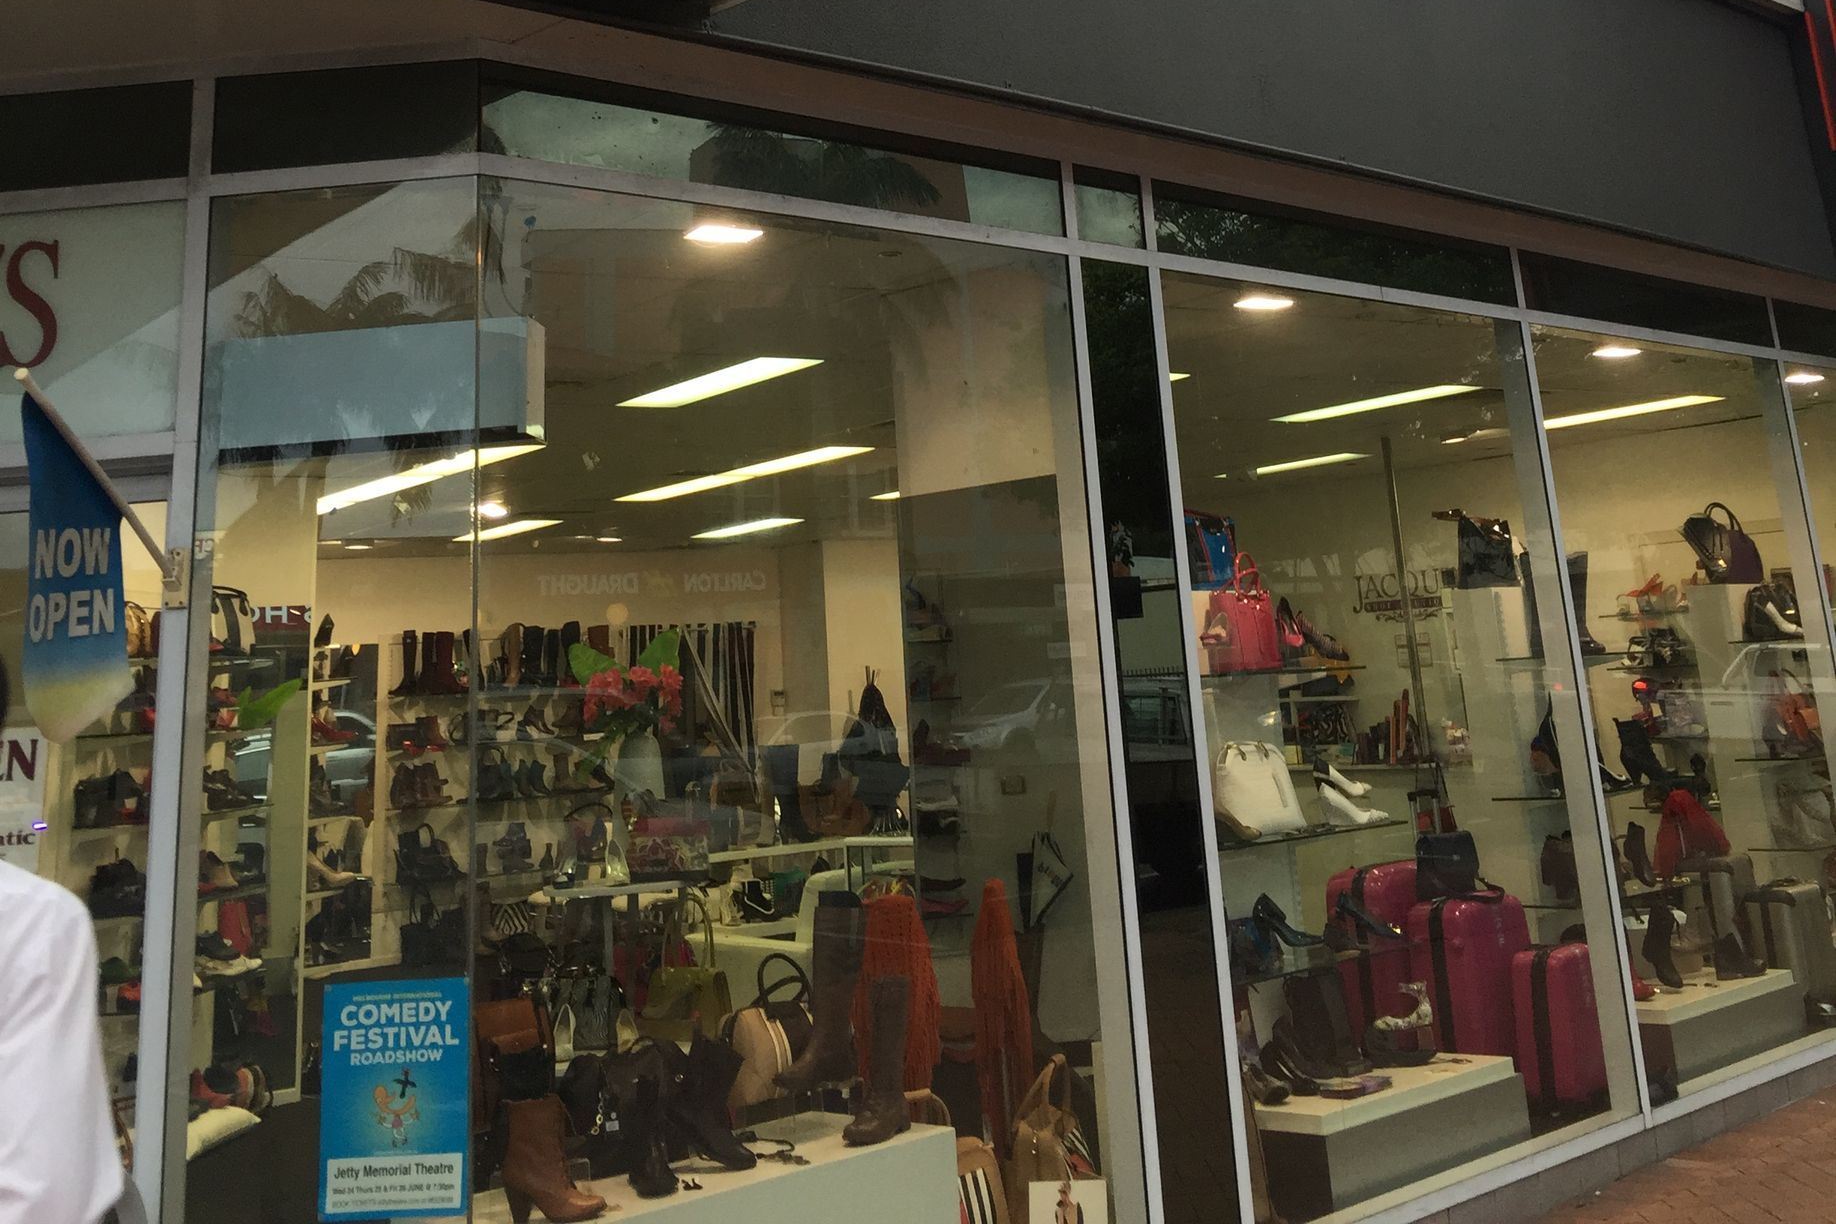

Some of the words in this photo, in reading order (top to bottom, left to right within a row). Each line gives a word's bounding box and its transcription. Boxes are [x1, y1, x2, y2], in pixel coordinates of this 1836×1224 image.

[35, 528, 111, 579] NOW
[1353, 568, 1440, 613] JACQU
[29, 588, 115, 643] OPEN
[340, 1000, 453, 1027] COMEDY
[333, 1024, 460, 1052] FESTIVAL
[350, 1048, 443, 1066] ROADSHOW
[334, 1166, 360, 1180] Jetty
[363, 1163, 411, 1178] Memorial
[414, 1161, 454, 1175] Theatre
